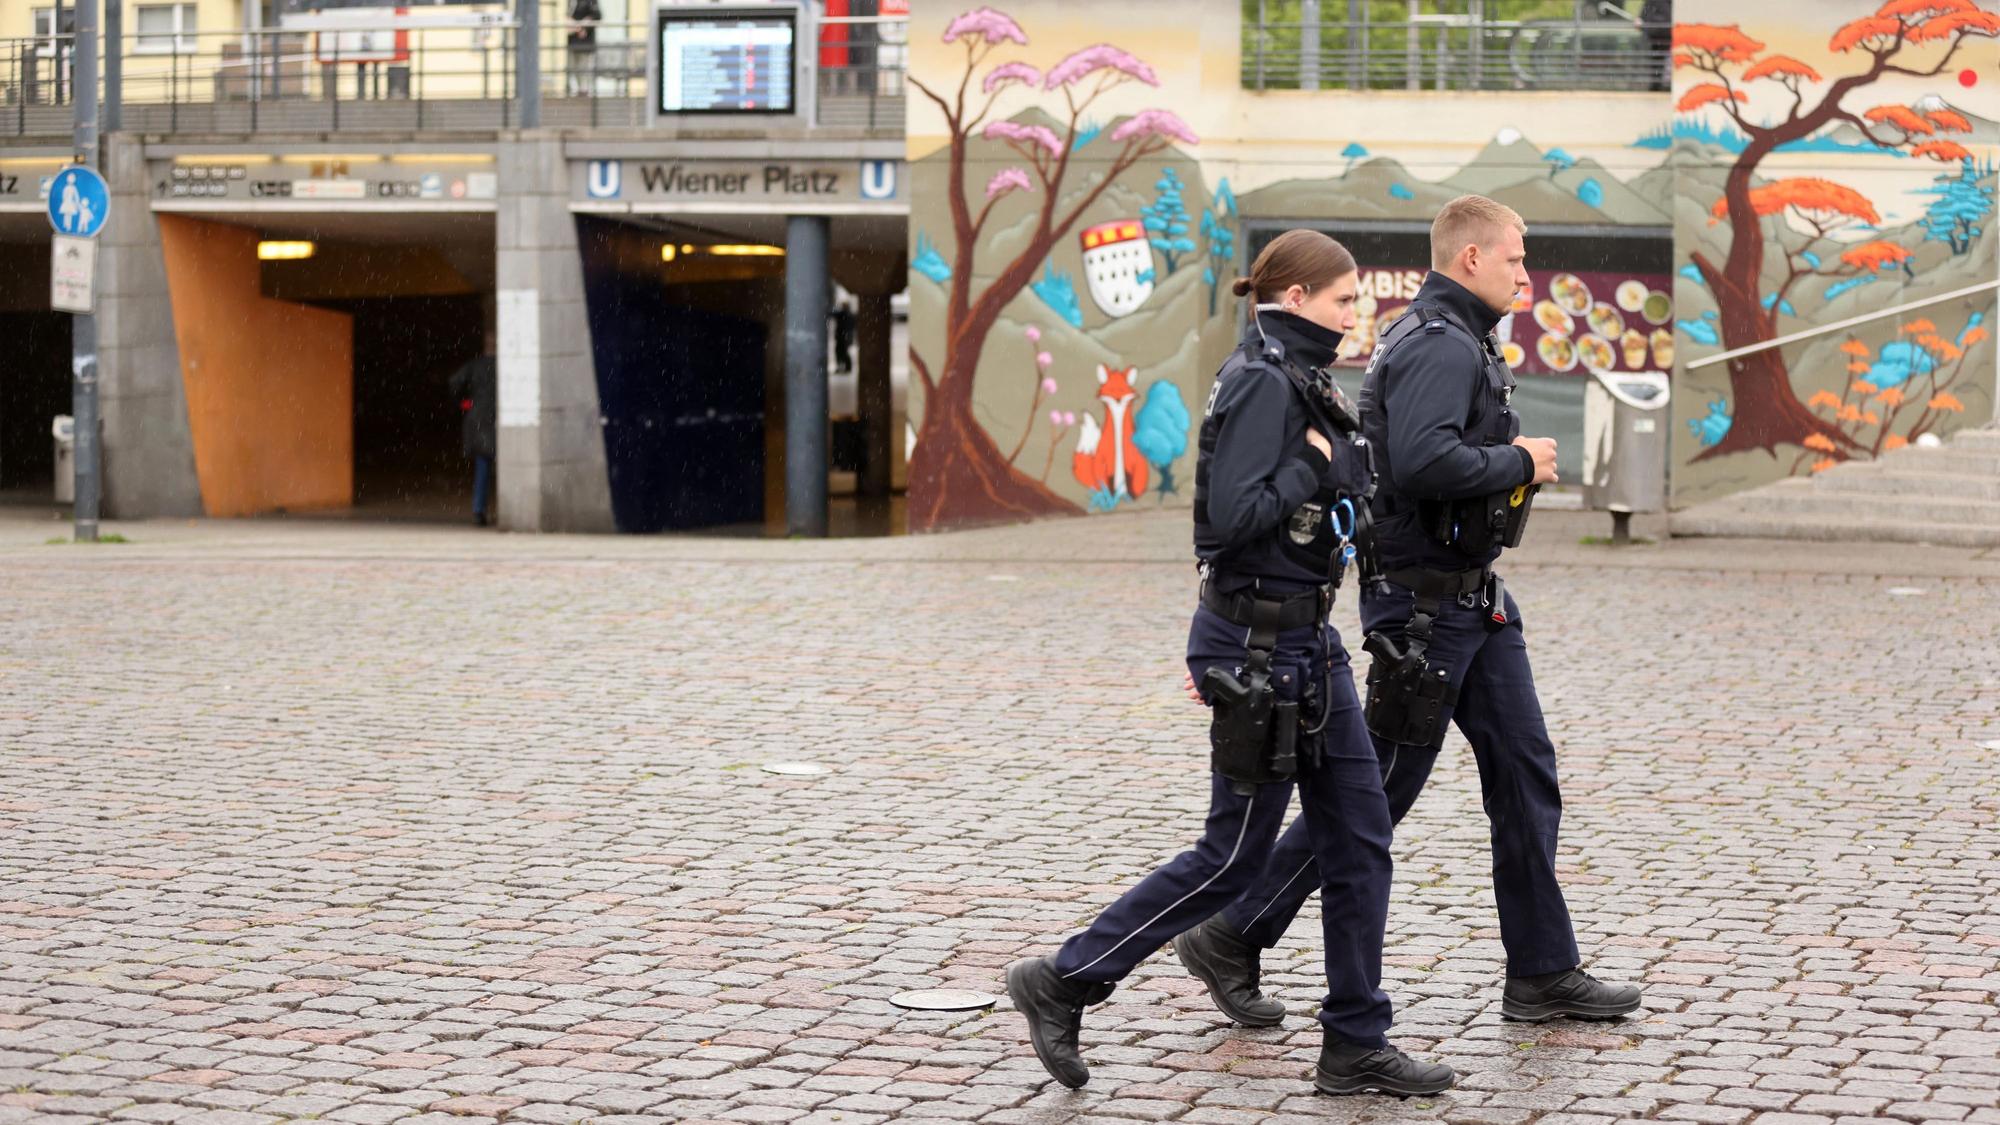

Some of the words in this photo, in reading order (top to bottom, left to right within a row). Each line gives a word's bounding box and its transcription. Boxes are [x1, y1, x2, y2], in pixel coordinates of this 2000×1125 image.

[587, 159, 621, 198] U
[640, 165, 751, 194] Wiener
[763, 165, 839, 194] Platz
[860, 159, 896, 199] U
[1355, 270, 1426, 300] MBIS
